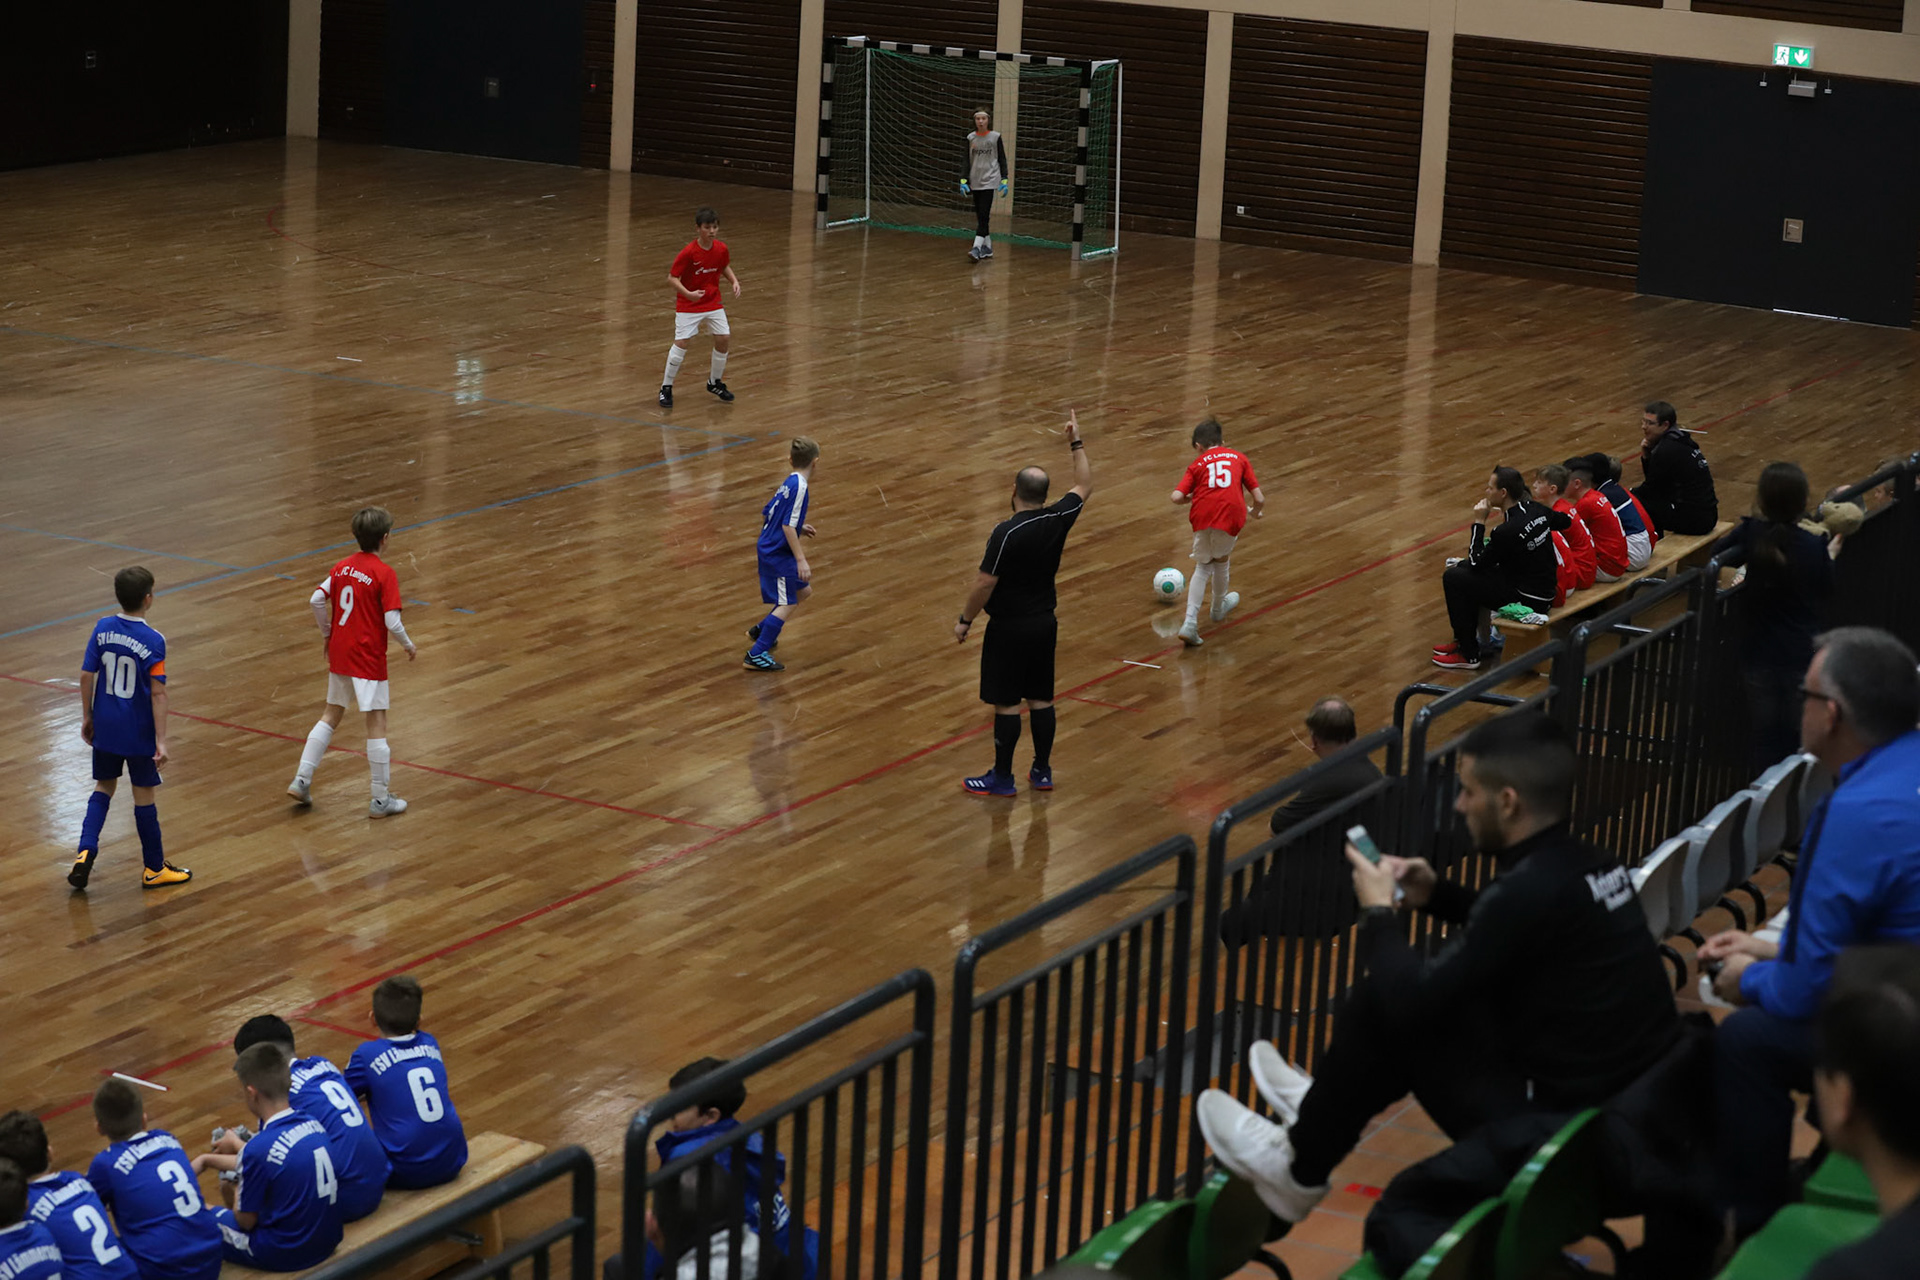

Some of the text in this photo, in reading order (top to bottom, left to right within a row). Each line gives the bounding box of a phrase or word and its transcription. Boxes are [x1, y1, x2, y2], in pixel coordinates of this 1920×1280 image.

[1203, 454, 1213, 462] FC
[1213, 452, 1238, 460] Langen
[1206, 460, 1232, 489] 15
[1524, 522, 1533, 533] FC
[349, 567, 373, 586] Langen
[338, 585, 354, 627] 9
[101, 650, 137, 699] 10
[369, 1052, 392, 1076] TSV
[320, 1080, 364, 1128] 9
[407, 1066, 444, 1123] 6
[113, 1150, 138, 1176] TSV
[266, 1140, 290, 1165] TSV
[157, 1159, 202, 1218] 3
[313, 1145, 338, 1206] 4
[30, 1195, 55, 1222] TSV
[72, 1204, 122, 1266] 2
